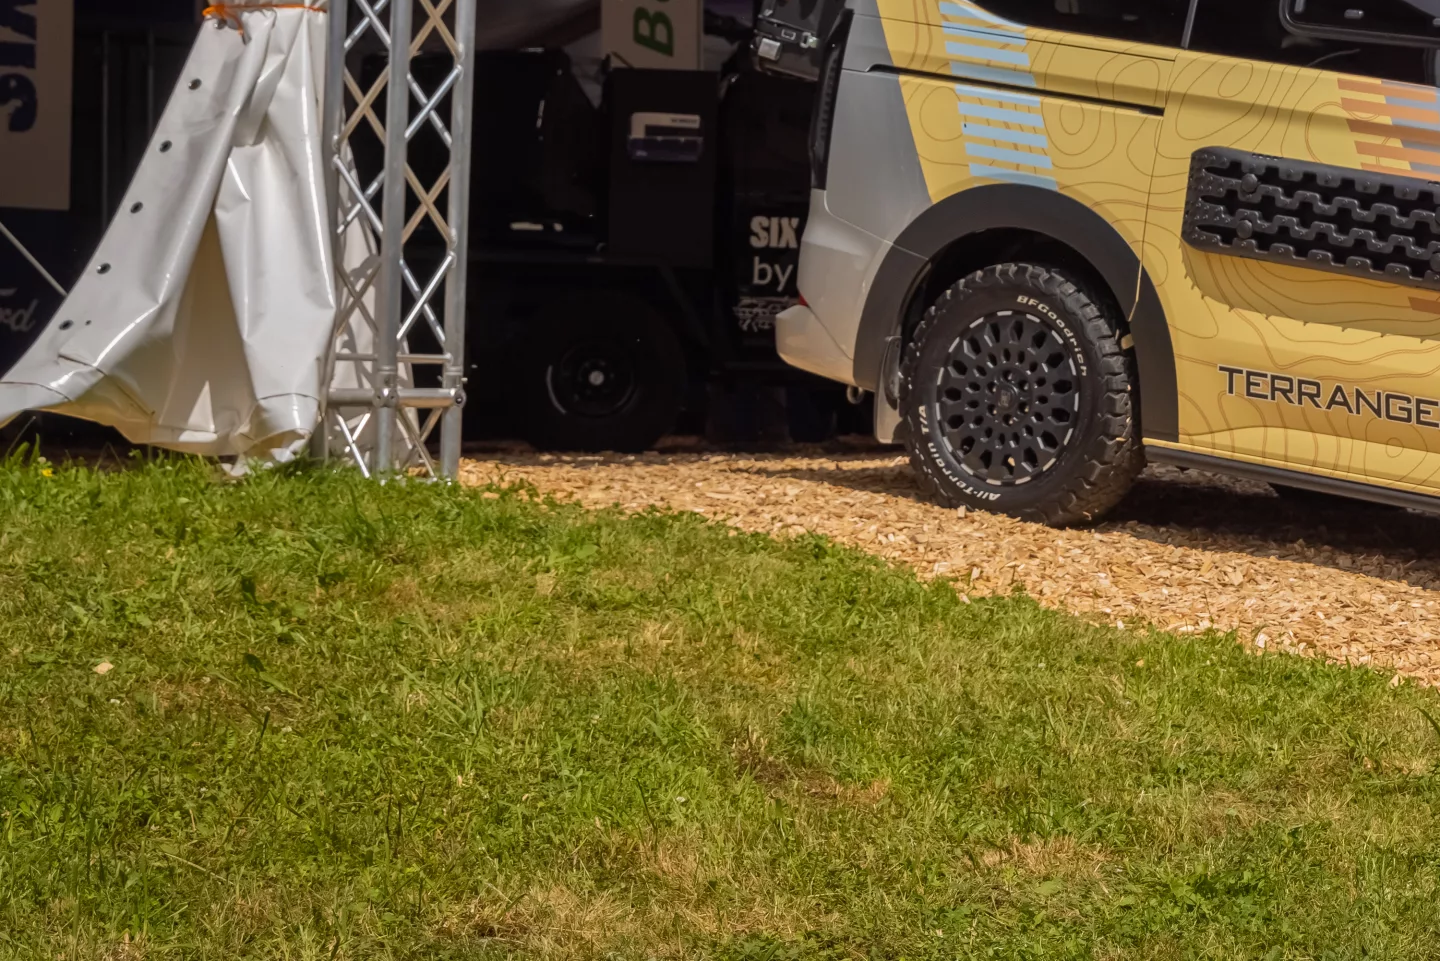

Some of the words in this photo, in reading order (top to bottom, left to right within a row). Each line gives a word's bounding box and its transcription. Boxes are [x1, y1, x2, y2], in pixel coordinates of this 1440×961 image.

[753, 256, 793, 292] by
[1017, 295, 1087, 377] BFGoodrich
[918, 405, 930, 435] T/A
[928, 442, 1001, 501] All-Terrain
